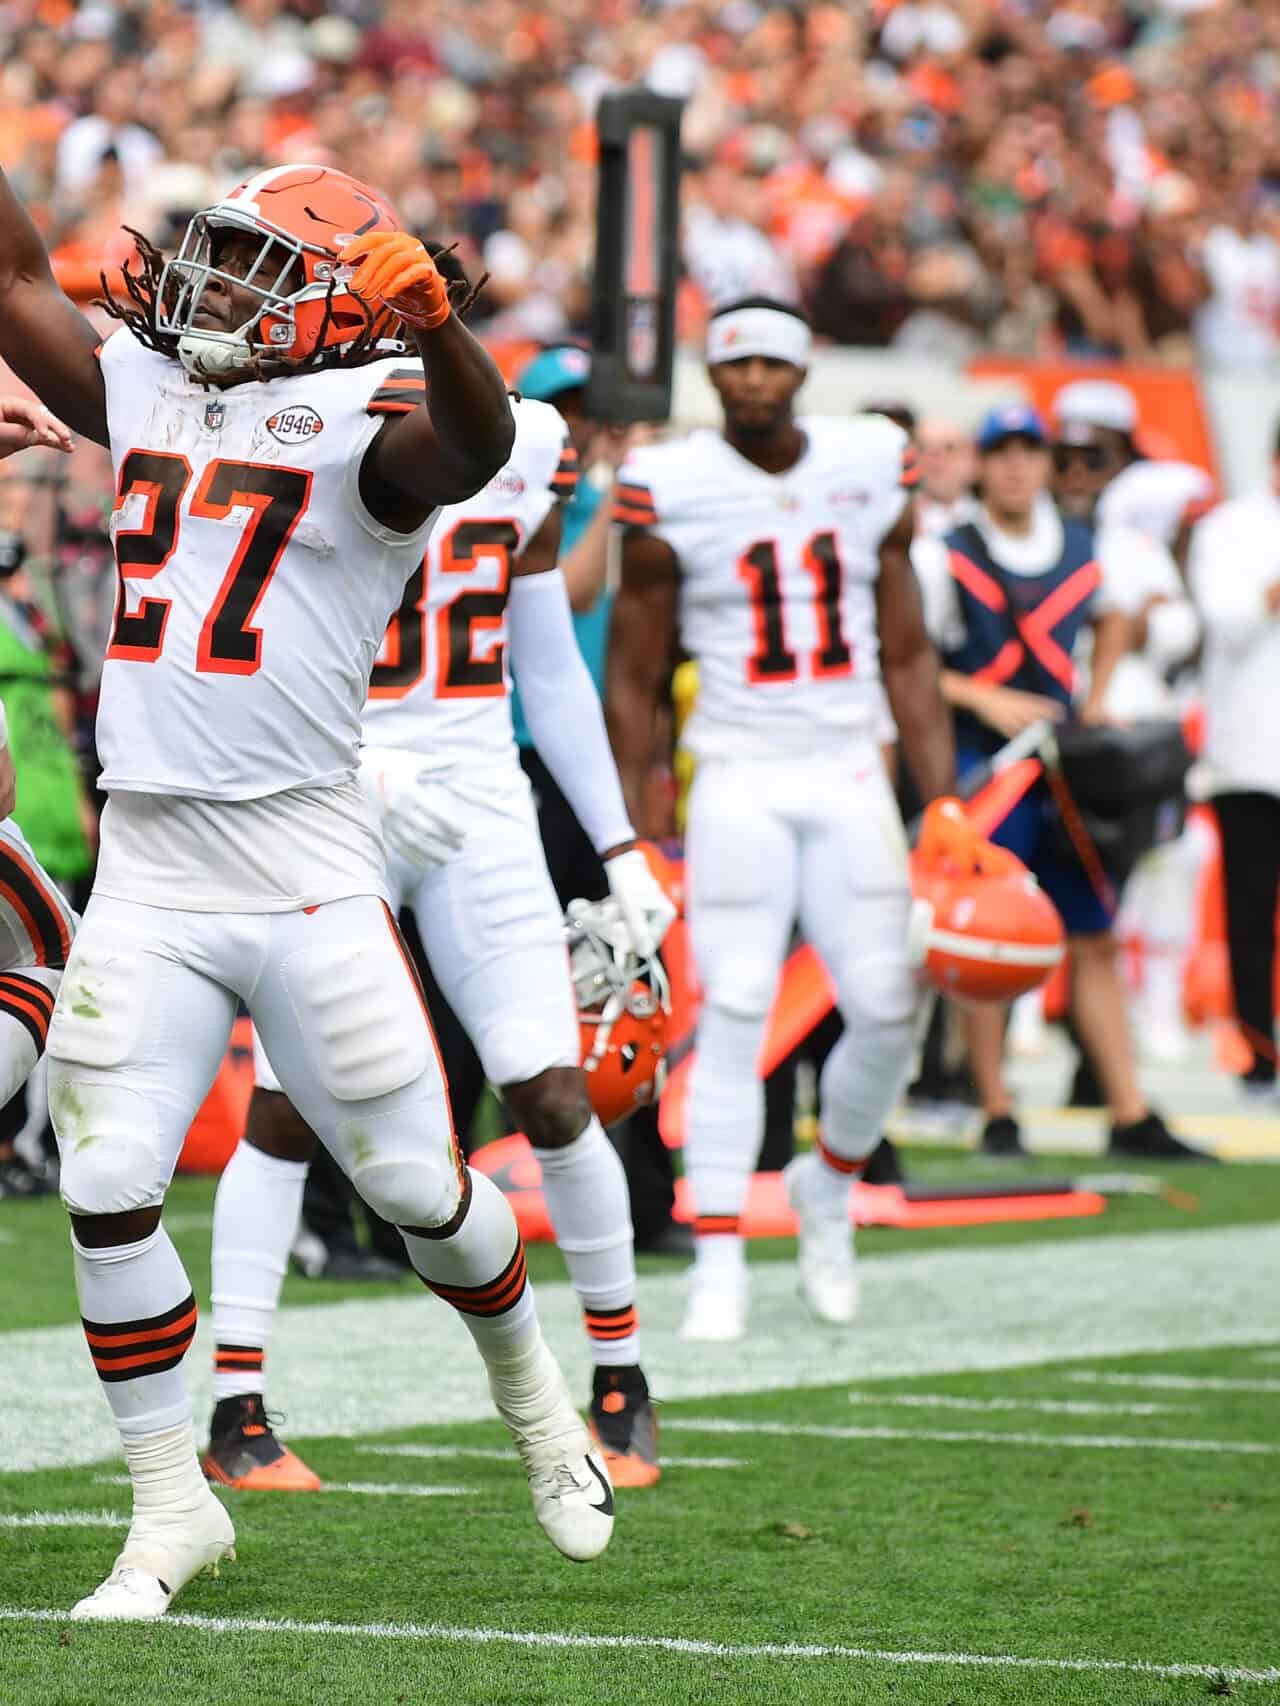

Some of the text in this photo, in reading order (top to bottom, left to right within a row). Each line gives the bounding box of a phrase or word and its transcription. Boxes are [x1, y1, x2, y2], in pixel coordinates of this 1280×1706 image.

[277, 413, 314, 435] 1946
[104, 447, 314, 677] 27
[738, 531, 854, 685] 11
